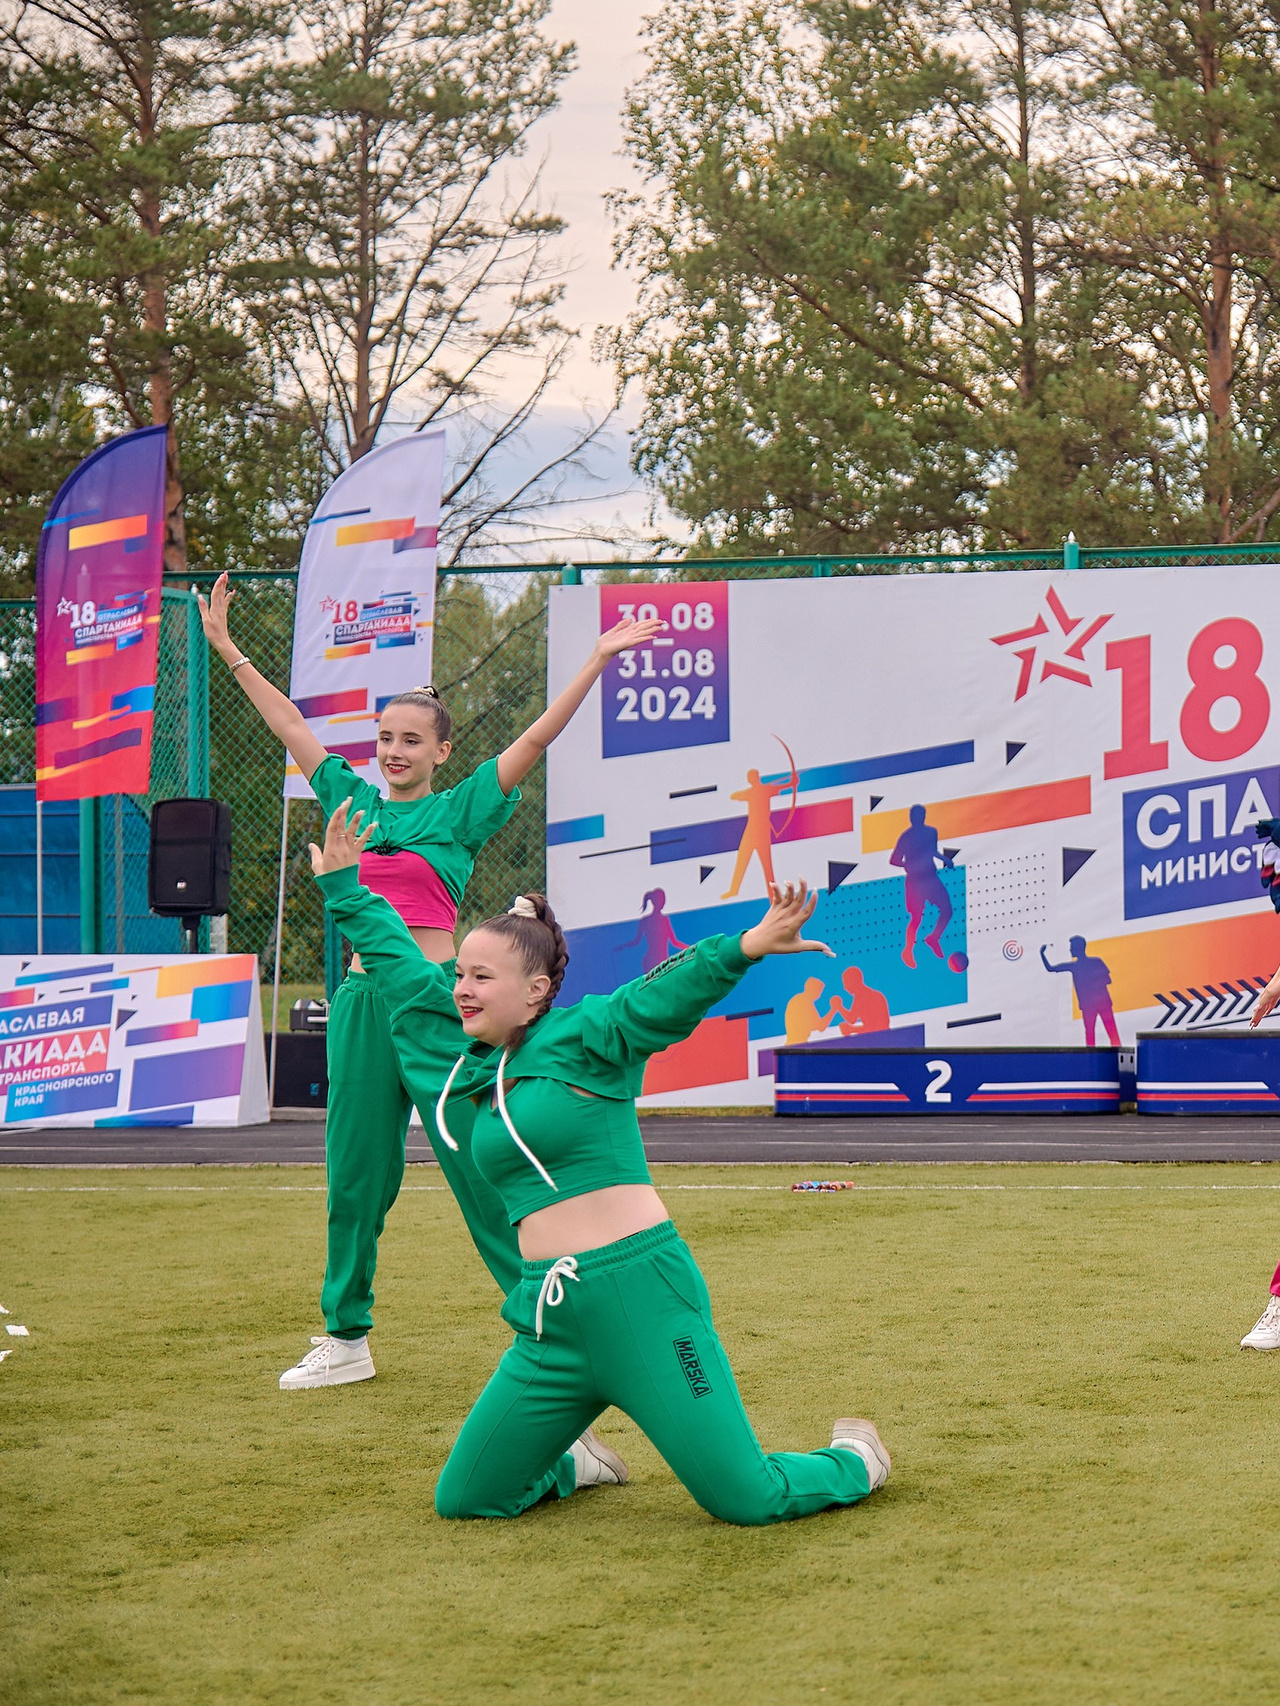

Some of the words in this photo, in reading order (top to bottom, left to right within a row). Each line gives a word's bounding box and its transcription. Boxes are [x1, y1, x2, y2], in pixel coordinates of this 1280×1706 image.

[70, 600, 96, 629] 18
[75, 613, 143, 639] СПАРТАКИАДА
[332, 599, 359, 624] 18
[336, 615, 411, 636] СПАРТАКИАДА
[617, 602, 715, 632] 30.08
[617, 648, 716, 680] 31.08
[615, 685, 717, 722] 2024
[1103, 616, 1270, 780] 18
[0, 1031, 107, 1070] КИАДА
[15, 1072, 114, 1098] КРАСНОЯРСКОГО
[925, 1060, 952, 1103] 2
[14, 1094, 44, 1108] КРАЯ
[675, 1340, 710, 1396] MARSKA
